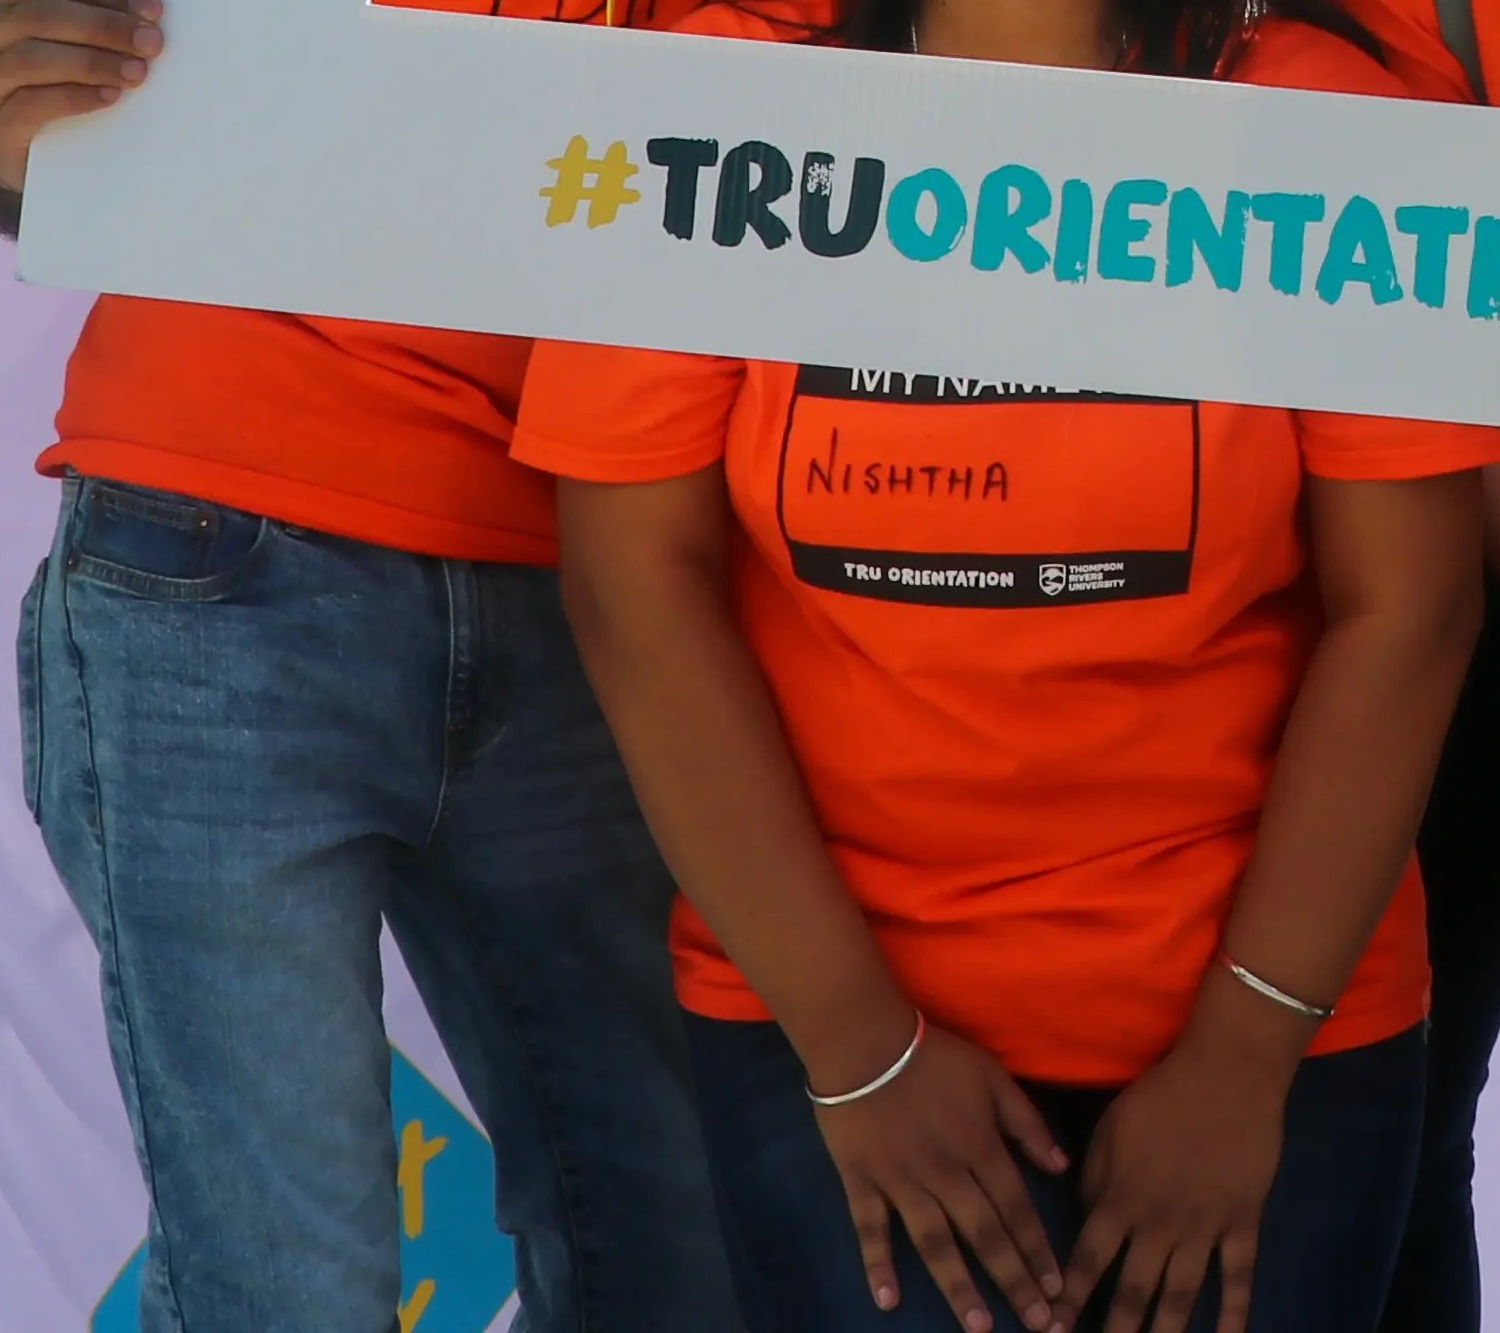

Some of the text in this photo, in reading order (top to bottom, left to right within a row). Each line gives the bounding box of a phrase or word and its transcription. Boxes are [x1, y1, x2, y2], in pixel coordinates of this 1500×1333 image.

[807, 428, 1008, 501] NISHTHA
[844, 562, 1014, 588] TRU ORIENTATION
[1069, 561, 1124, 573] THOMPSON
